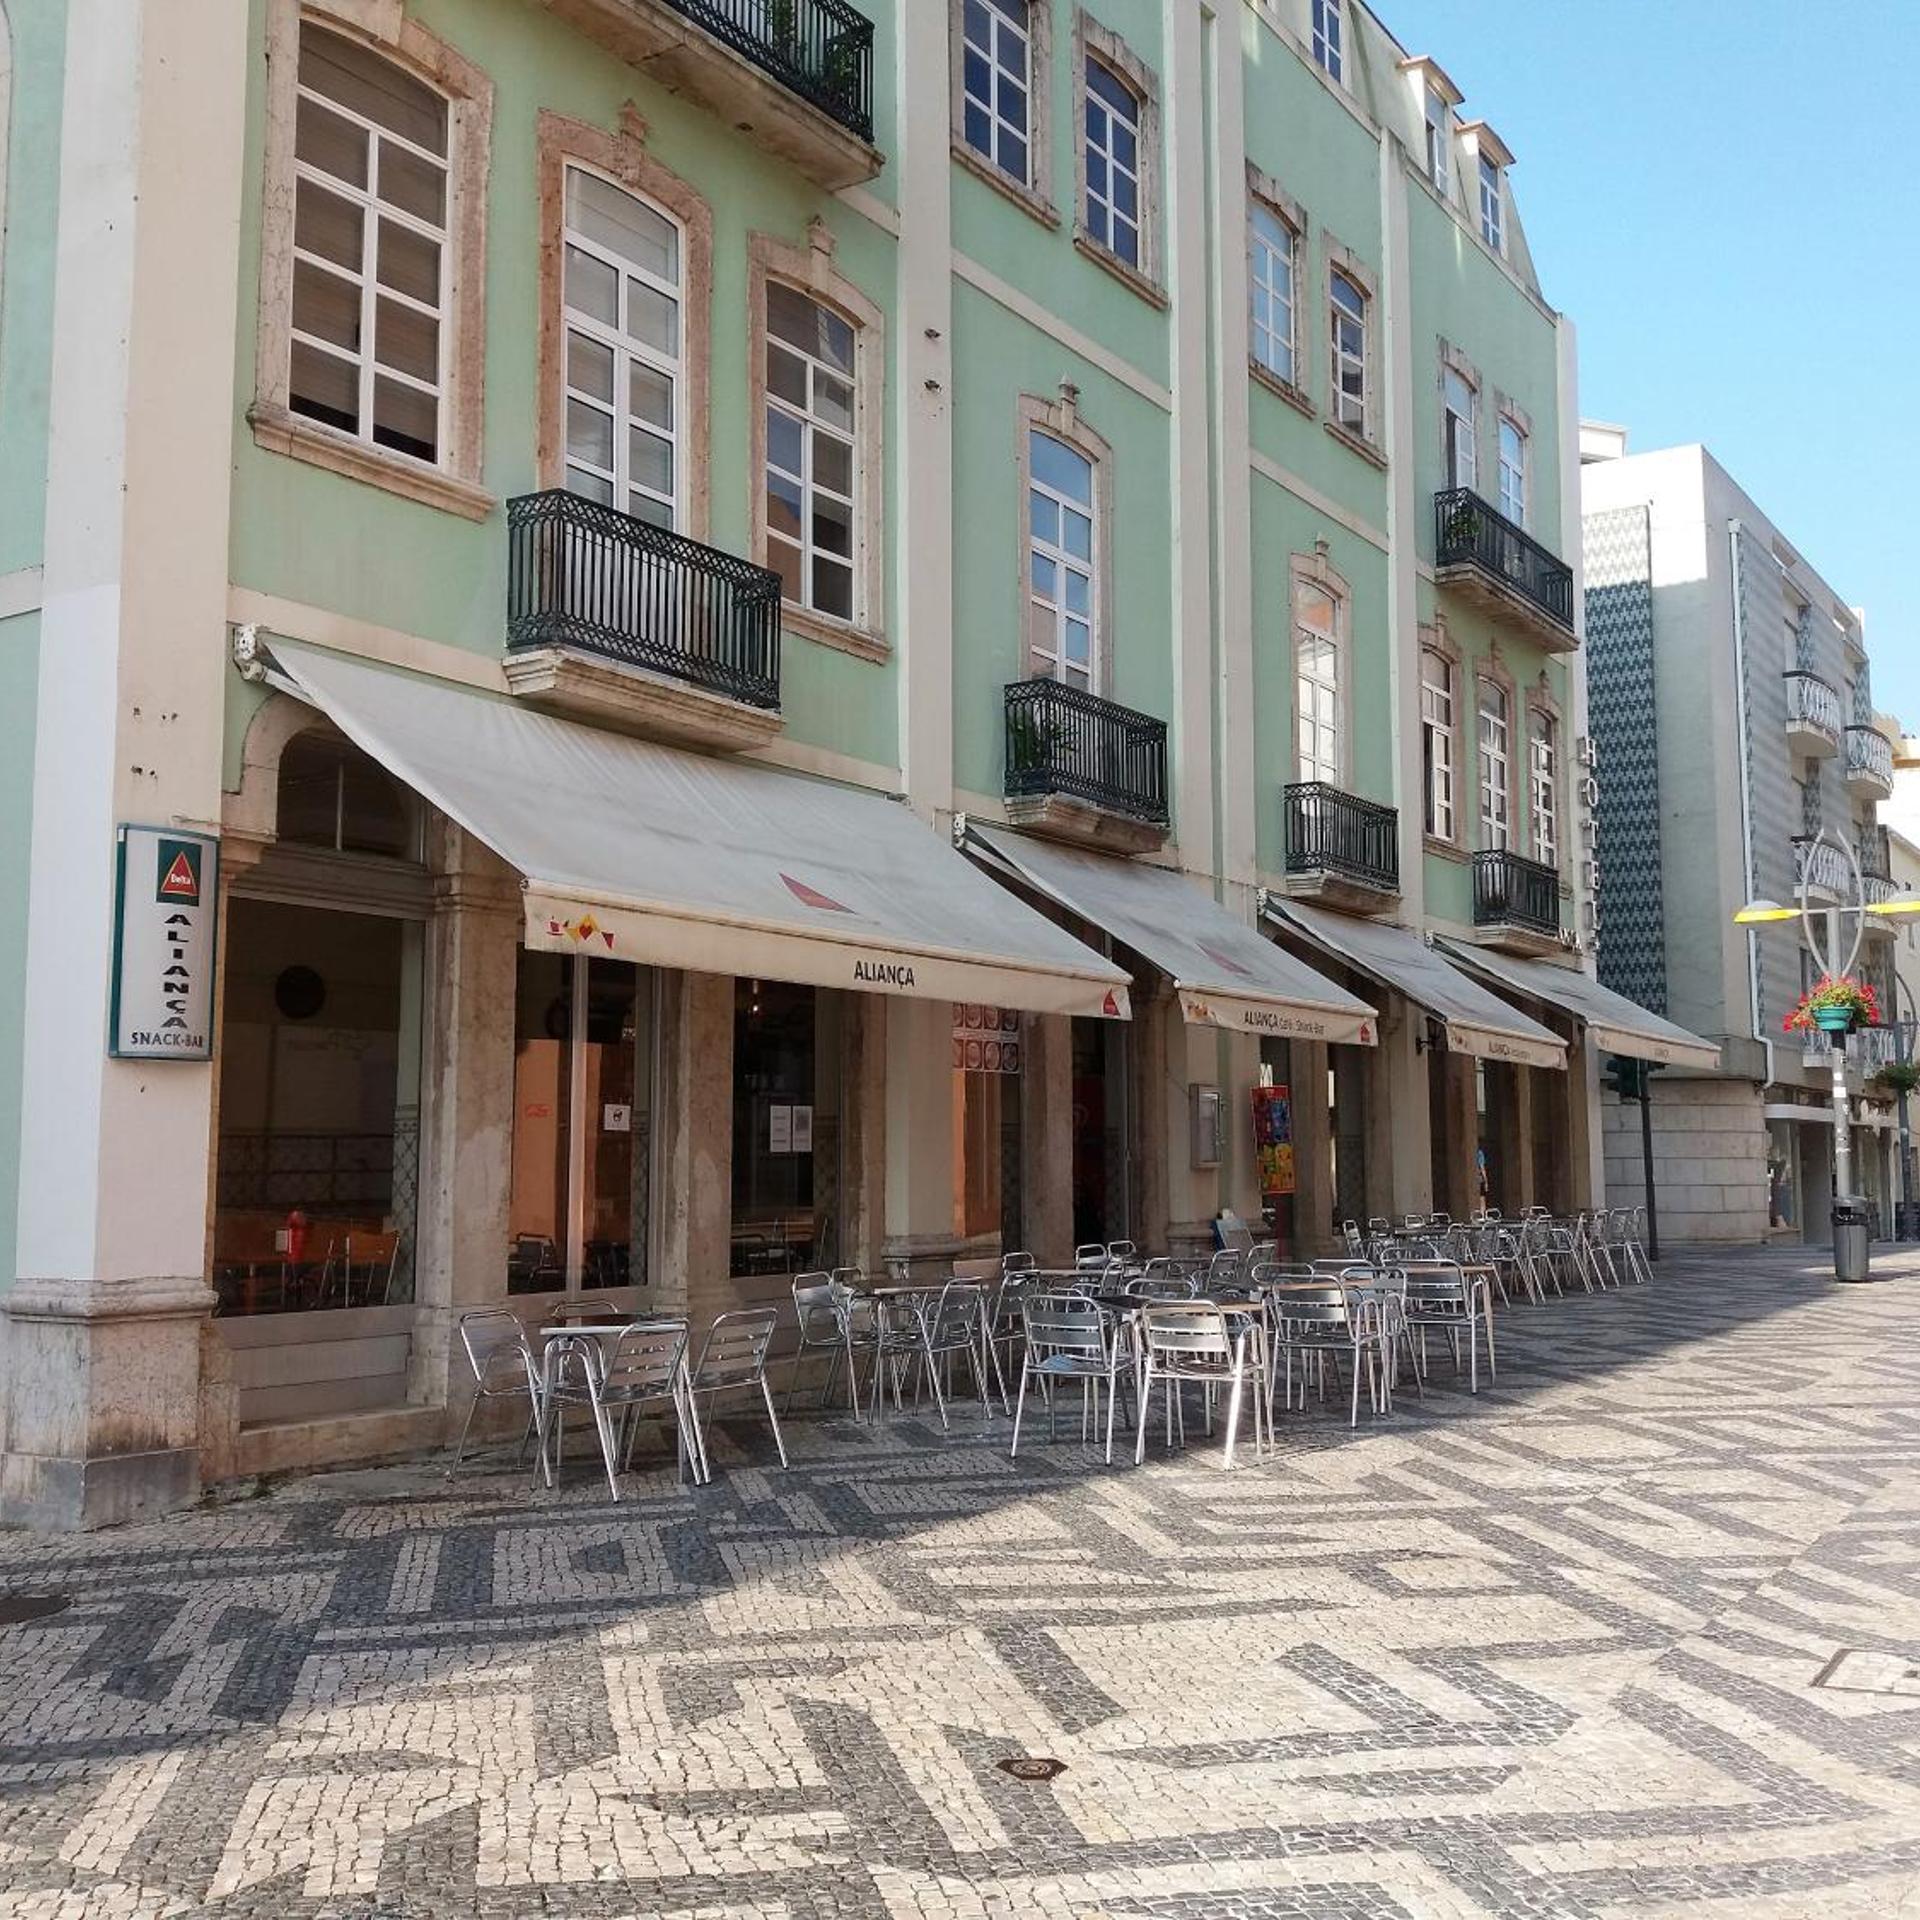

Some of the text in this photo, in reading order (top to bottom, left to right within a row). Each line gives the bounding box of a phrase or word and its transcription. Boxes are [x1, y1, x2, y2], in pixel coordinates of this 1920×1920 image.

[1579, 737, 1600, 930] HOTEL
[162, 914, 192, 1028] ALIANÇA
[854, 961, 915, 989] ALIANÇA
[131, 1031, 203, 1048] SNACK-BAR
